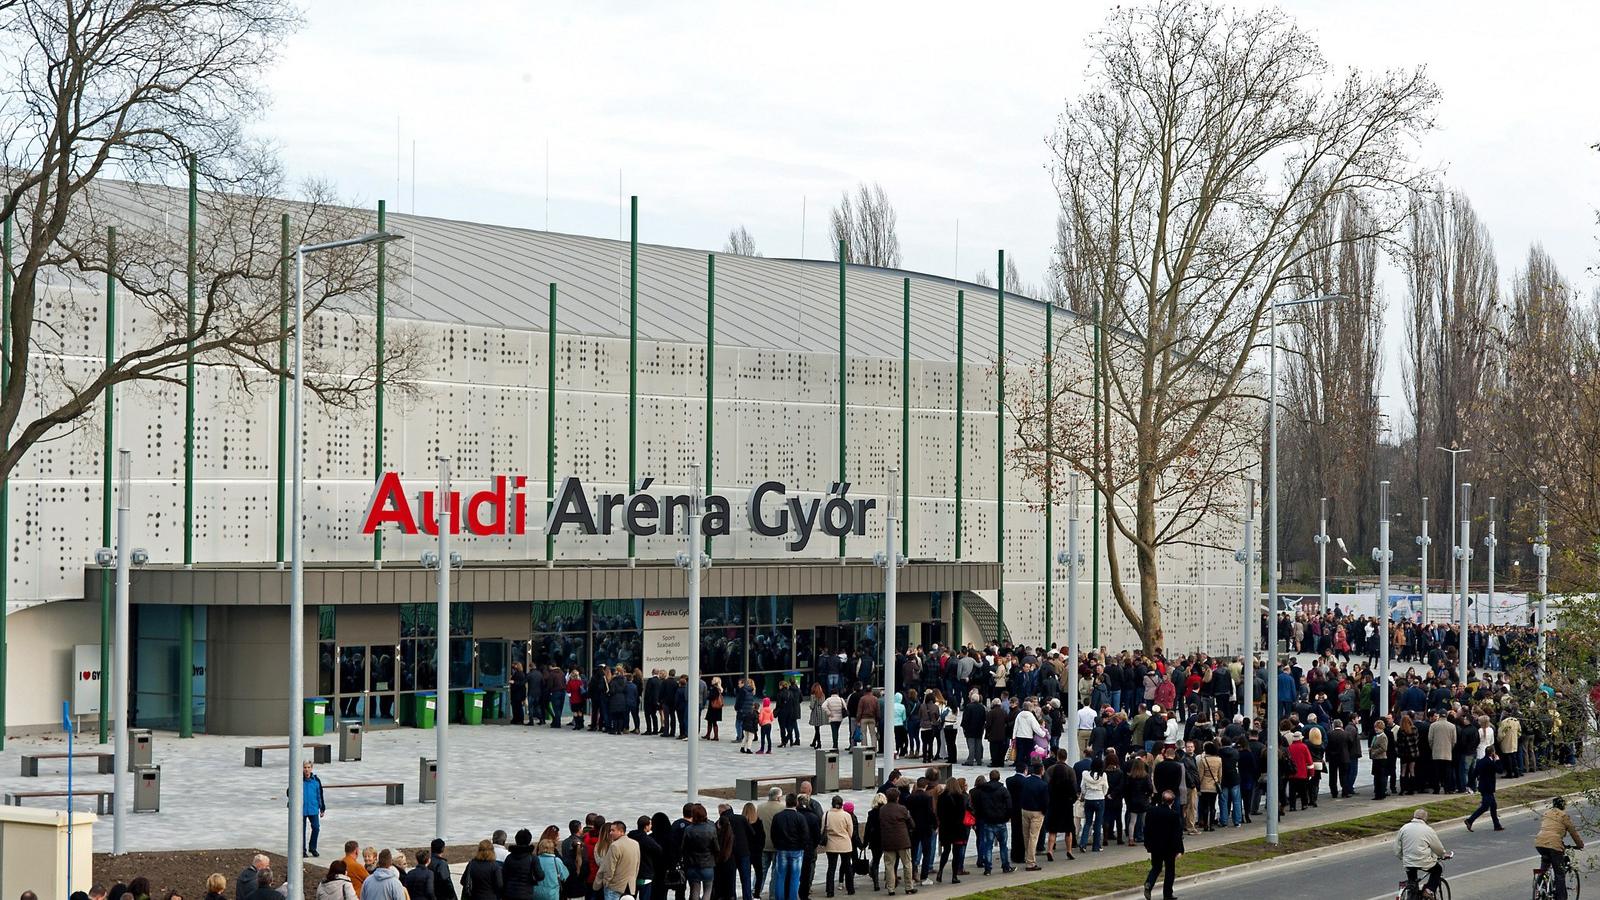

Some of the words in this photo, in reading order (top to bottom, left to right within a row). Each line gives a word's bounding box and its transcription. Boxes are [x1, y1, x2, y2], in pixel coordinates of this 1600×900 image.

[359, 472, 526, 536] Audi
[546, 477, 730, 537] Aréna
[749, 480, 876, 552] Győr
[661, 608, 678, 616] Aréna
[679, 608, 689, 617] Győ
[79, 671, 82, 681] I
[92, 671, 101, 680] GY
